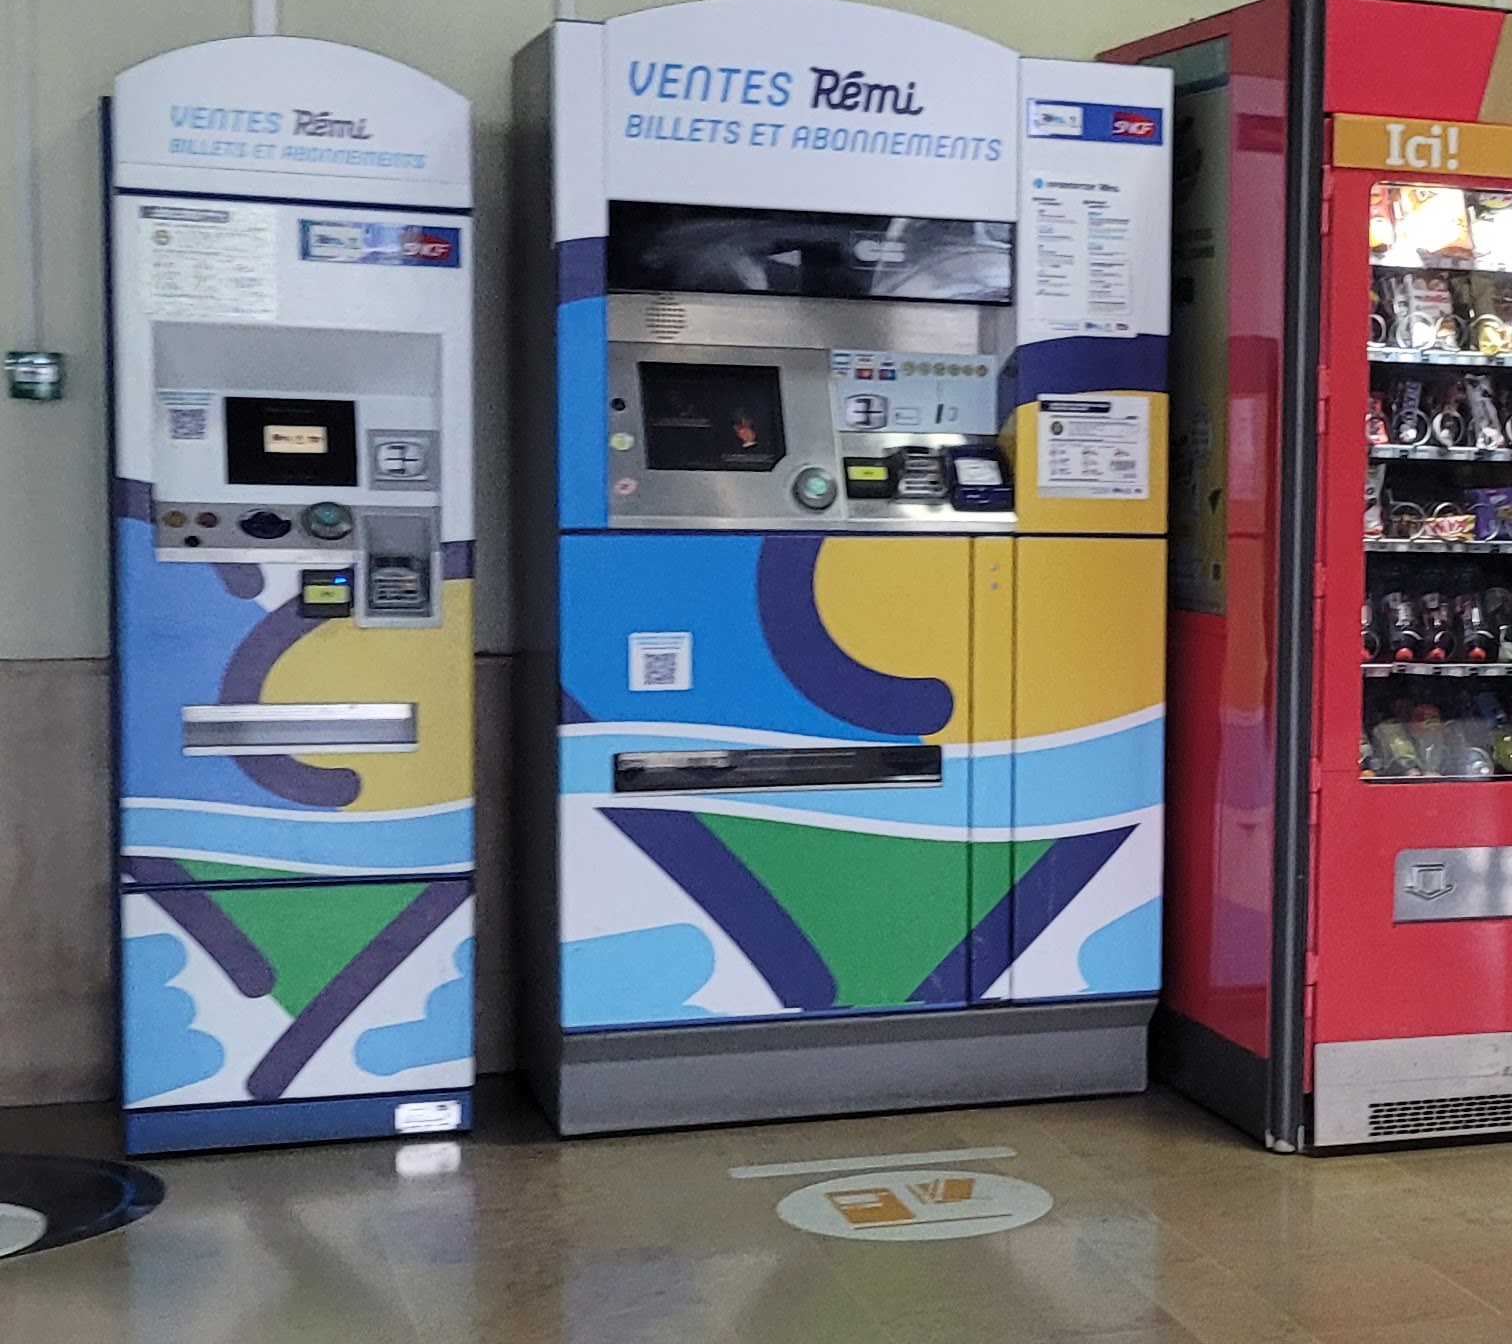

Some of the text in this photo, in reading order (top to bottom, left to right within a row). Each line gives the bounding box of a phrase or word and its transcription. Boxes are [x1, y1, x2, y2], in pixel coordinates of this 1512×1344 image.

[629, 60, 924, 116] VENTES Rémi
[169, 105, 373, 140] VENTES Rémi
[624, 113, 1002, 161] BILLETS ET ABONNEMENTS
[1384, 123, 1460, 171] Ici!
